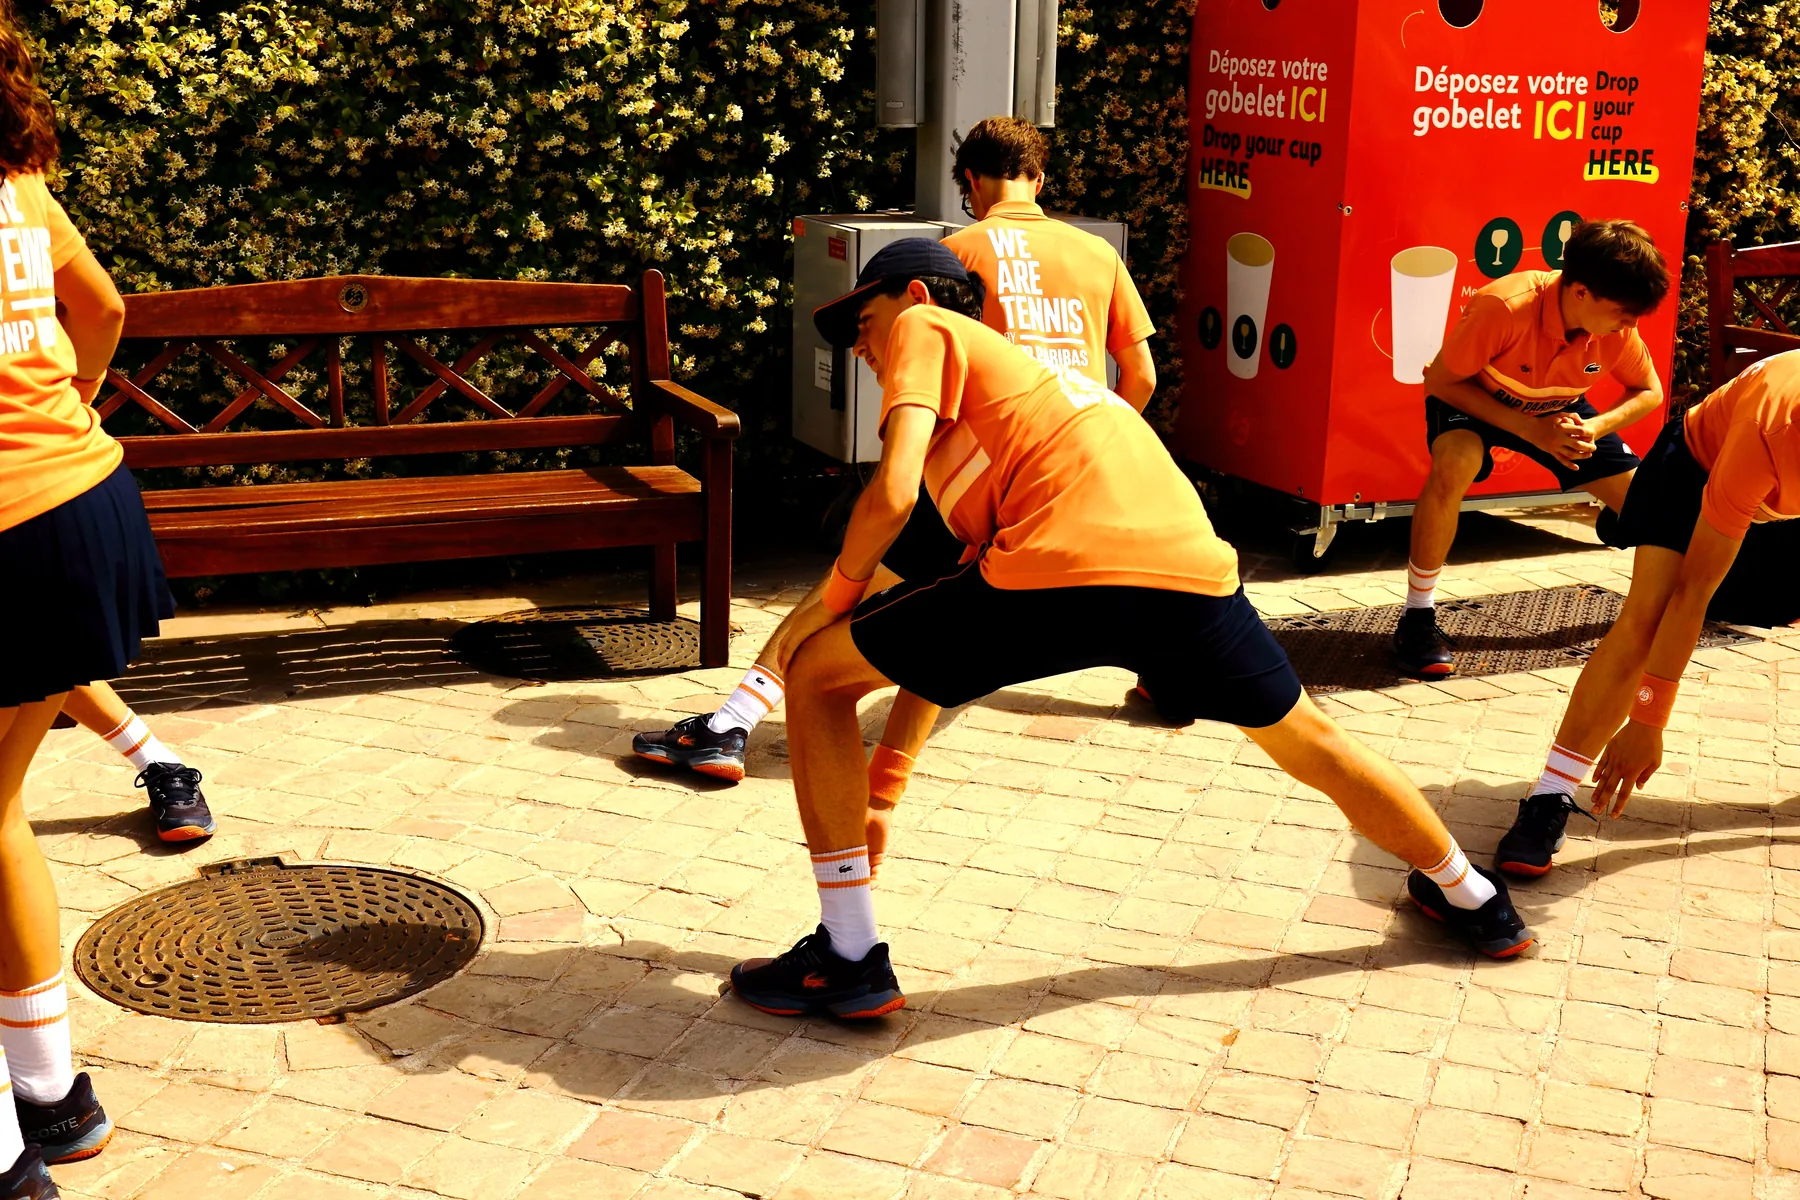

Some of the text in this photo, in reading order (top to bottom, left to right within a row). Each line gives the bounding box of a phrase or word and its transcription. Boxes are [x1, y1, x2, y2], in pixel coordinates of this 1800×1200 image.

[1209, 49, 1328, 82] Déposez votre
[1414, 65, 1589, 101] Déposez votre
[1595, 71, 1639, 95] Drop
[1205, 81, 1327, 123] gobelet ICI
[1594, 101, 1635, 121] your
[1413, 98, 1587, 140] gobelet ICI
[1591, 125, 1623, 145] cup
[1203, 123, 1322, 167] Drop your cup
[1200, 157, 1249, 190] HERE
[1588, 148, 1654, 176] HERE
[987, 228, 1032, 259] WE
[997, 259, 1043, 296] ARE
[998, 295, 1084, 335] TENNIS
